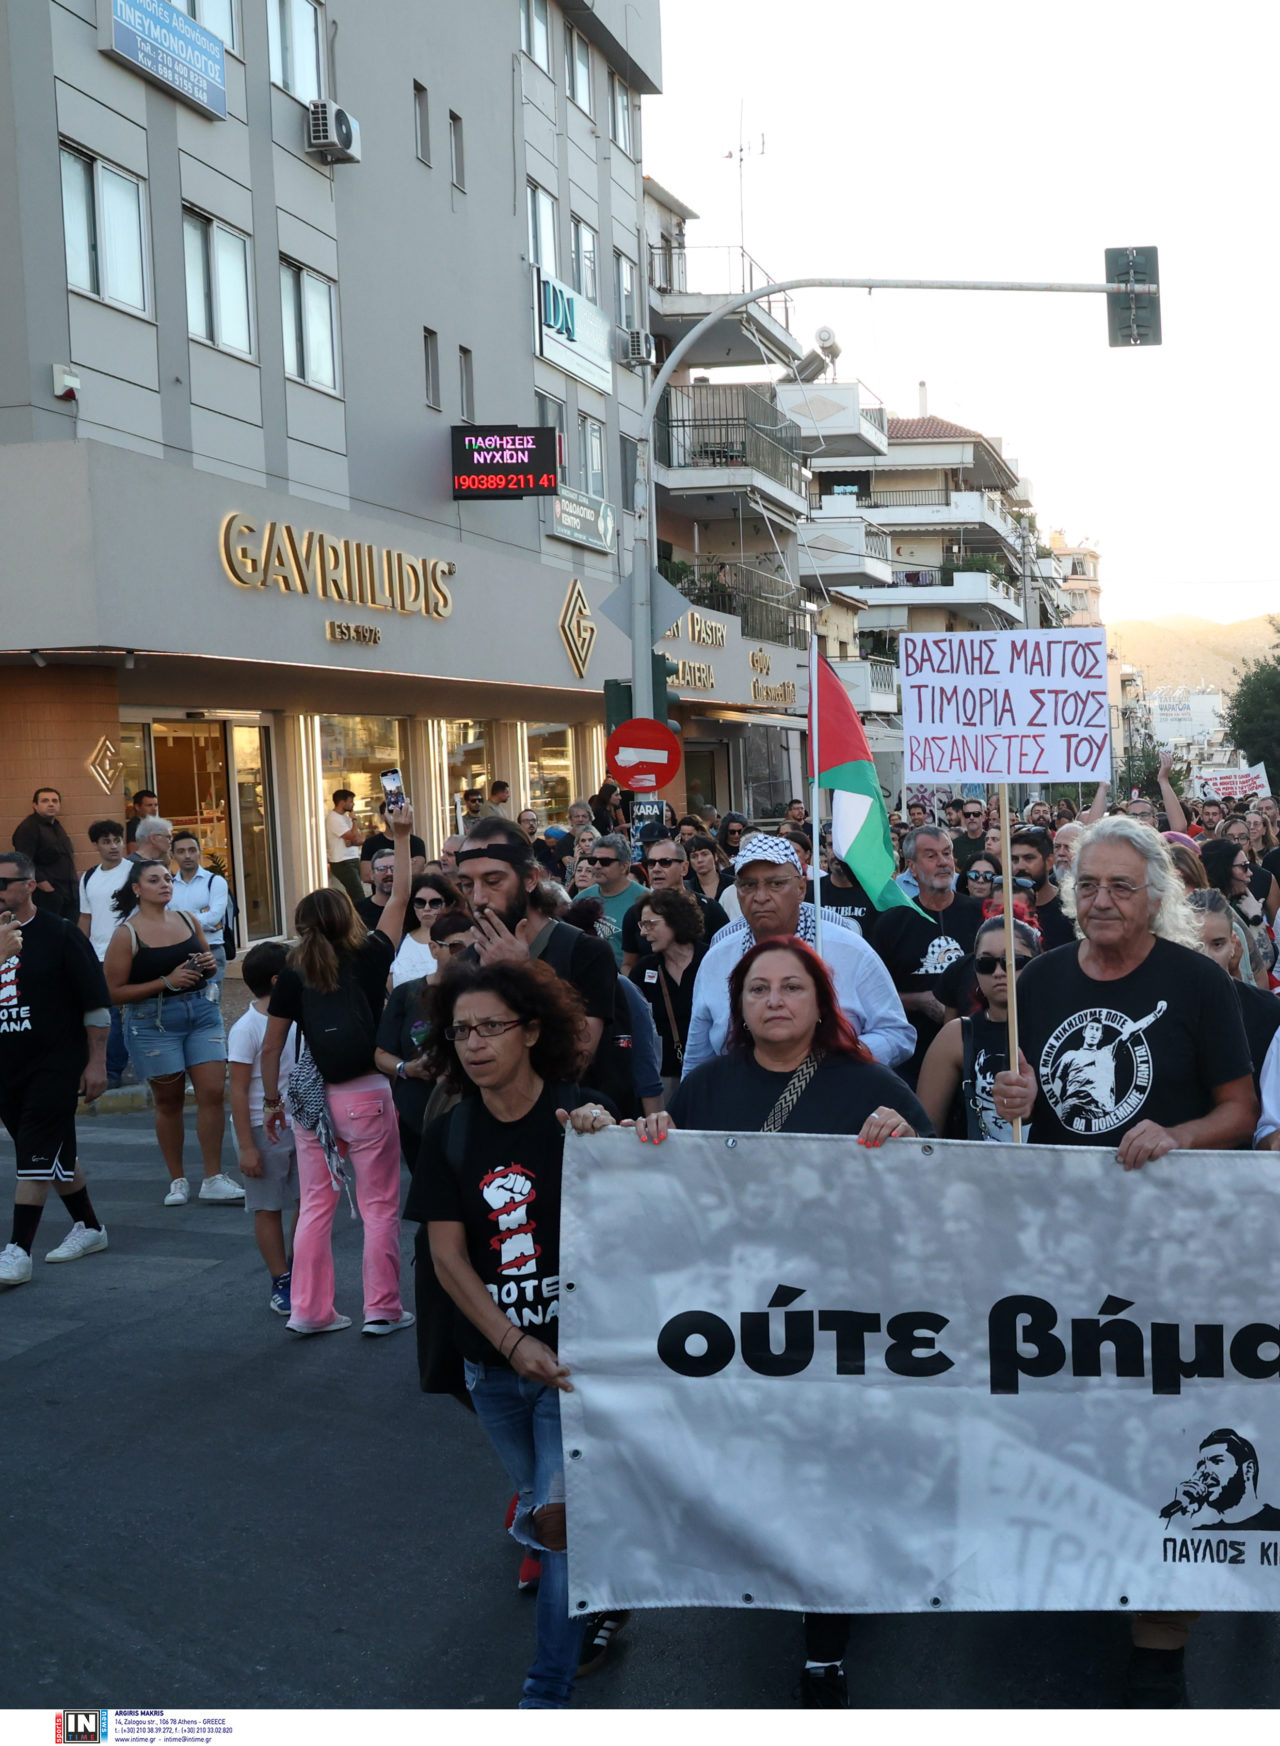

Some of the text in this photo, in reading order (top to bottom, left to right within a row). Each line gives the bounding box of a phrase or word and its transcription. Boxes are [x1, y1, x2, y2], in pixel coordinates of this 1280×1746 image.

[117, 0, 221, 83] ΠΝΕΥΜΟΝΟΛΟΓΟΣ
[158, 50, 172, 68] 210
[539, 474, 556, 488] 41
[357, 624, 382, 645] 1978
[694, 612, 727, 647] PASTRY
[658, 652, 715, 689] LATERIA
[905, 638, 1103, 678] ΒΑΣΙΛΗΣ ΜΑΓΓΟΣ
[910, 685, 1106, 728] ΤΙΜΩΡΙΑ ΣΤΟΥΣ
[910, 733, 1108, 775] ΒΑΣΑΝΙΣΤΕΣ ΤΟΥ
[1041, 1010, 1128, 1107] ΚΑΙ ΑΣ ΜΗΝ ΝΙΚΗΣΟΥΜΕ ΠΟΤΕ
[1072, 1117, 1086, 1132] ΘΑ
[1091, 1089, 1145, 1132] ΠΟΛΕΜΑΜΕ
[505, 1299, 559, 1328] ΑΝΑ
[657, 1284, 955, 1378] ούτε
[1162, 1537, 1246, 1565] ΠΑΥΛΟΣ
